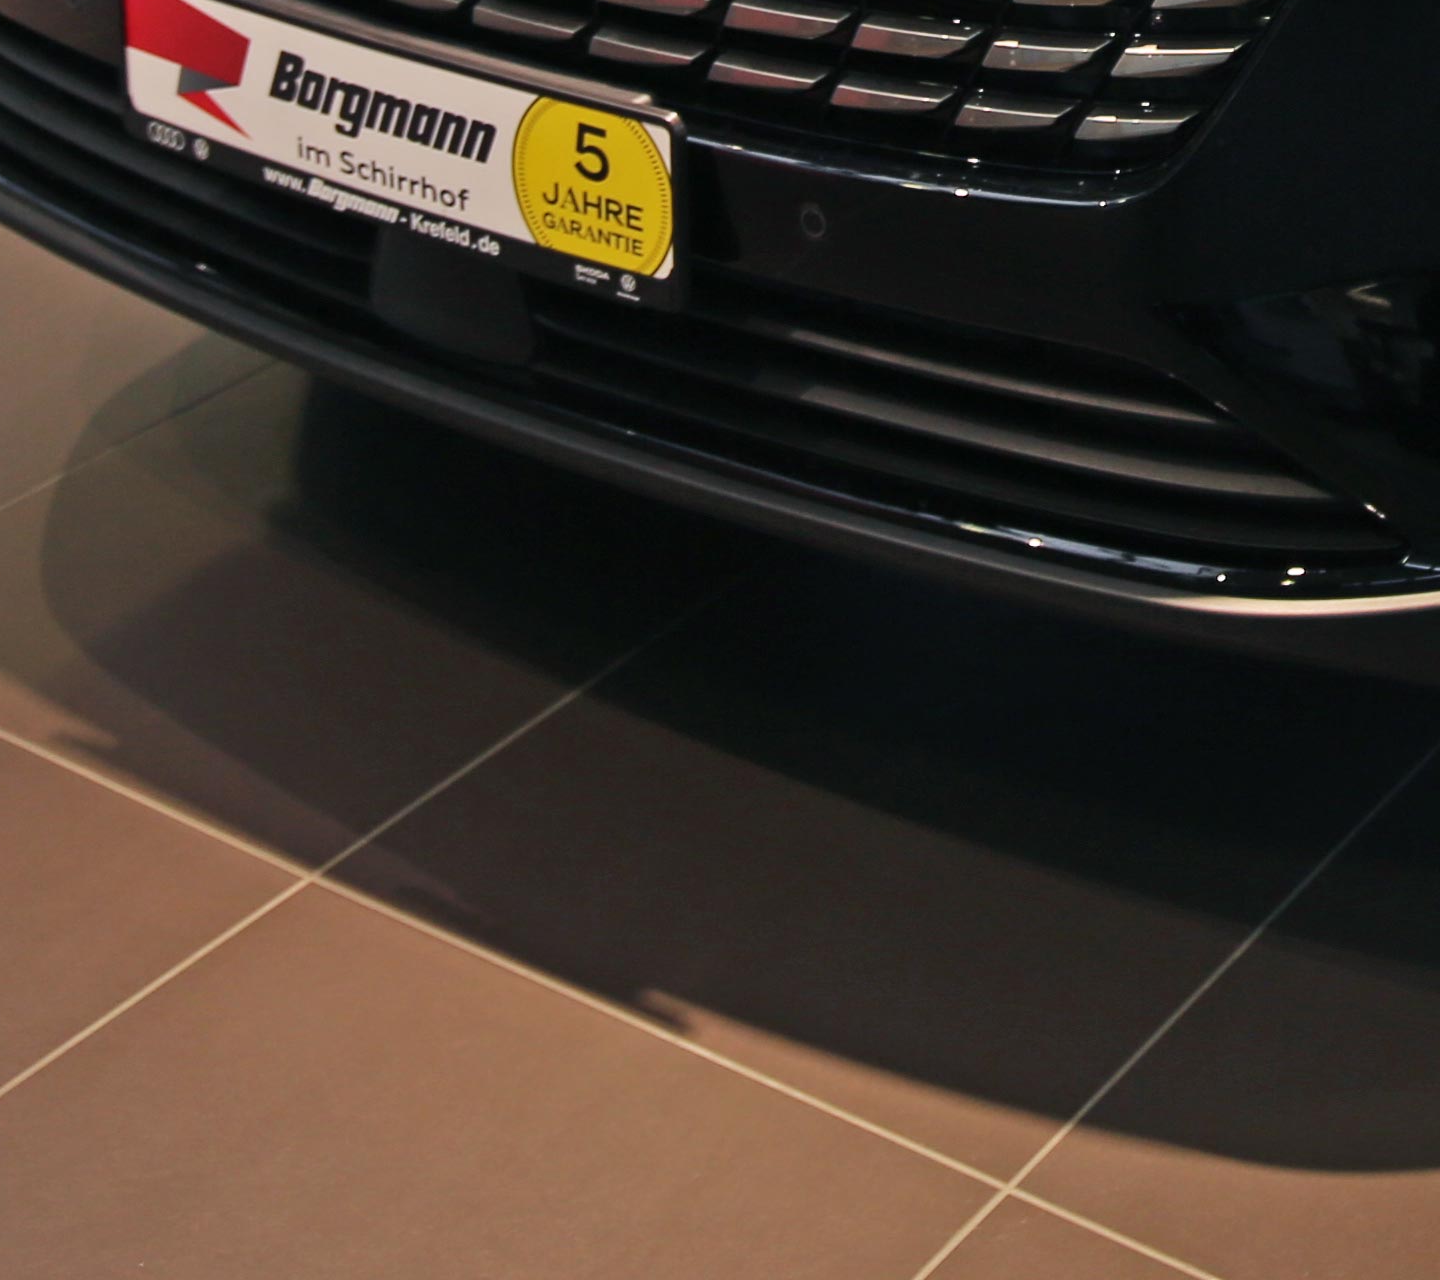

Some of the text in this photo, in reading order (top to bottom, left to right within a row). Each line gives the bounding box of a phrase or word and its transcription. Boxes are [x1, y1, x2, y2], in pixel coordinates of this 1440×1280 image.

[269, 50, 497, 164] Borgmann
[297, 137, 471, 212] im Schirrhof
[575, 122, 610, 183] 5
[542, 182, 644, 233] JAHRE
[542, 212, 645, 258] GARANTIE
